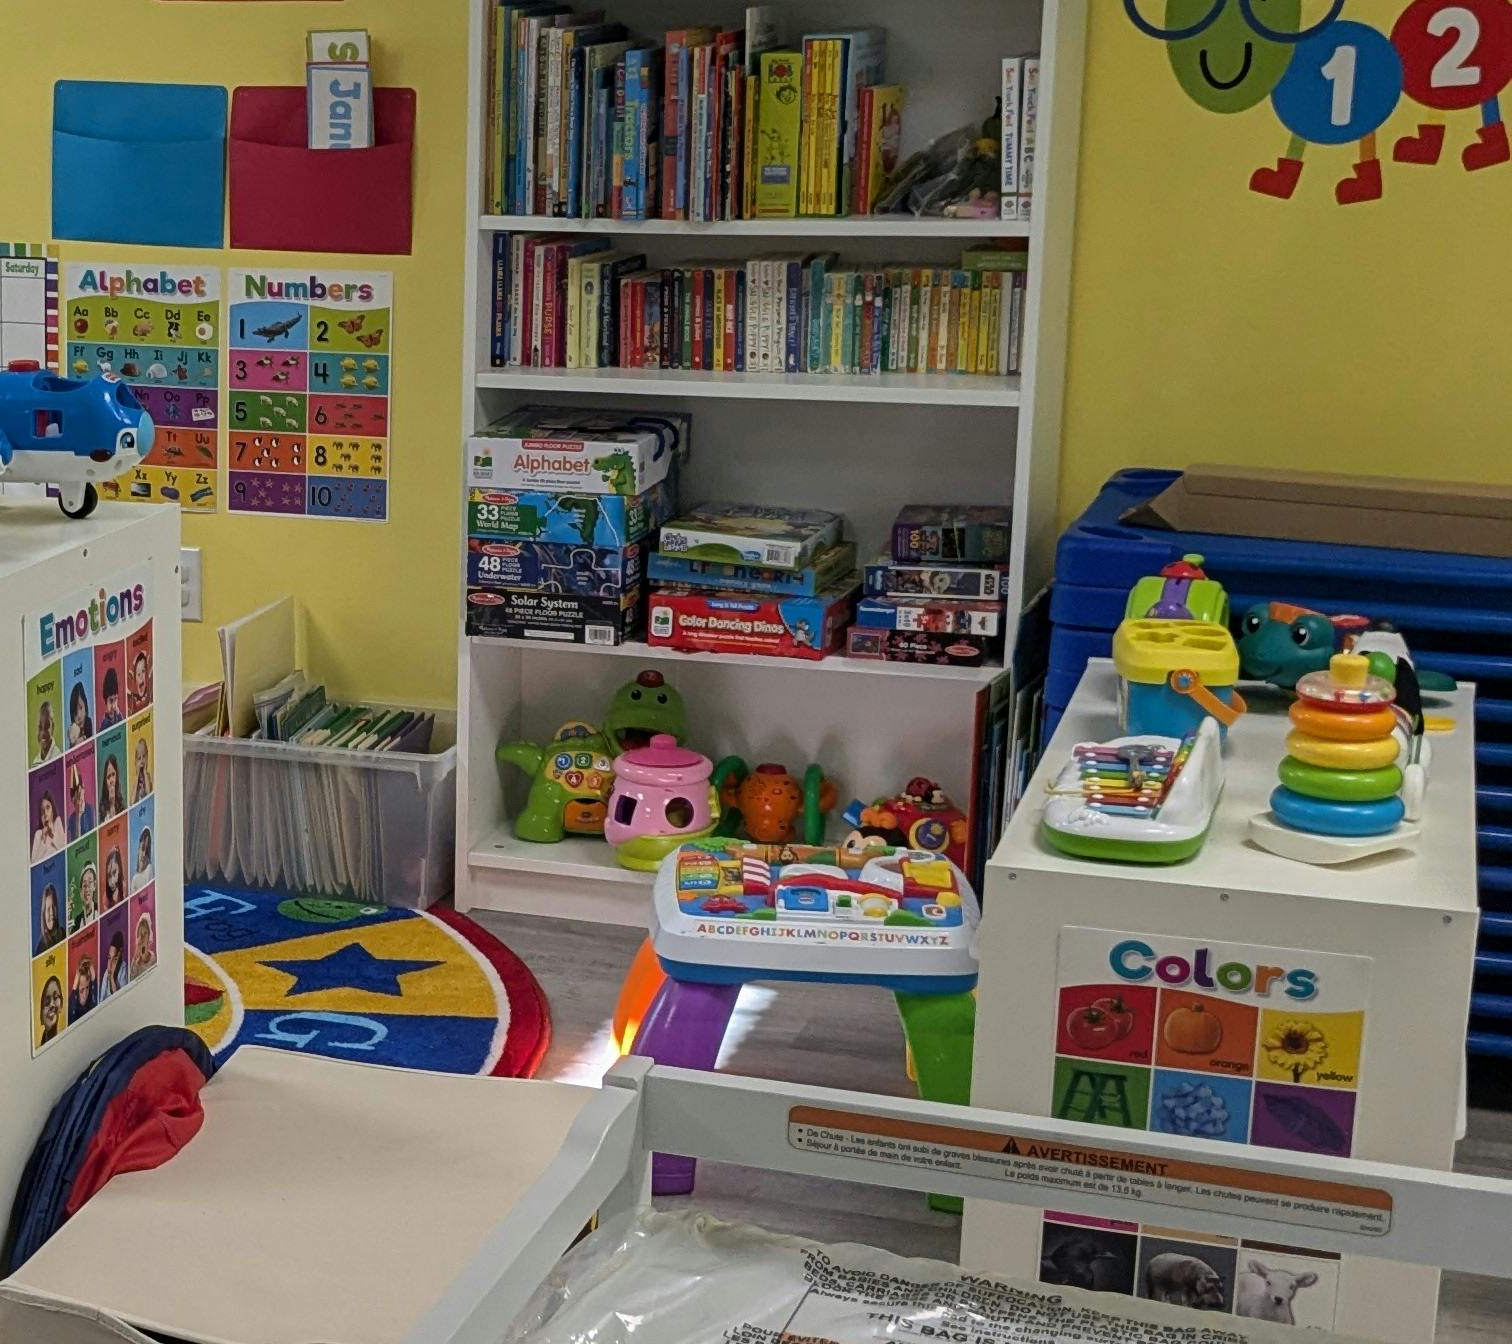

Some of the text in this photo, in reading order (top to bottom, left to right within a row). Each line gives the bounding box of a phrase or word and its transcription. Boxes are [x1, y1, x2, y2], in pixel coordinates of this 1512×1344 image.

[1427, 6, 1481, 88] 2
[1320, 46, 1357, 126] 1
[5, 262, 39, 276] Saturday
[78, 269, 207, 300] Alphabet
[244, 274, 374, 302] Numbers
[73, 306, 211, 322] Aa Bb Cc Dd Ee
[239, 318, 245, 339] 1
[316, 320, 328, 342] 2
[74, 346, 212, 364] Ff Gg Hh Ii Jj Kk
[235, 360, 247, 380] 3
[314, 362, 329, 383] 4
[235, 401, 247, 421] 5
[315, 406, 328, 425] 6
[235, 441, 247, 461] 7
[314, 445, 327, 466] 8
[513, 454, 590, 474] Alphabet
[135, 469, 148, 480] Xx
[164, 471, 178, 484] Yy
[234, 482, 246, 501] 9
[310, 486, 333, 506] 10
[477, 504, 499, 520] 33
[476, 520, 519, 532] World Map
[478, 556, 501, 571] 48
[478, 570, 522, 582] Underwater
[511, 594, 578, 611] Solar System
[39, 583, 144, 656] Emotions
[558, 610, 584, 618] PUZZLE
[678, 614, 785, 634] Color Dancing Dinos
[73, 663, 83, 677] sad
[36, 679, 55, 696] happy
[1109, 939, 1319, 1002] Colors
[1209, 1058, 1250, 1073] orange
[1316, 1070, 1354, 1083] yellow
[1027, 1144, 1168, 1176] AVERTISSEMENT
[960, 1275, 1063, 1304] WARNING
[867, 1312, 914, 1329] THIS
[920, 1324, 969, 1344] BAG
